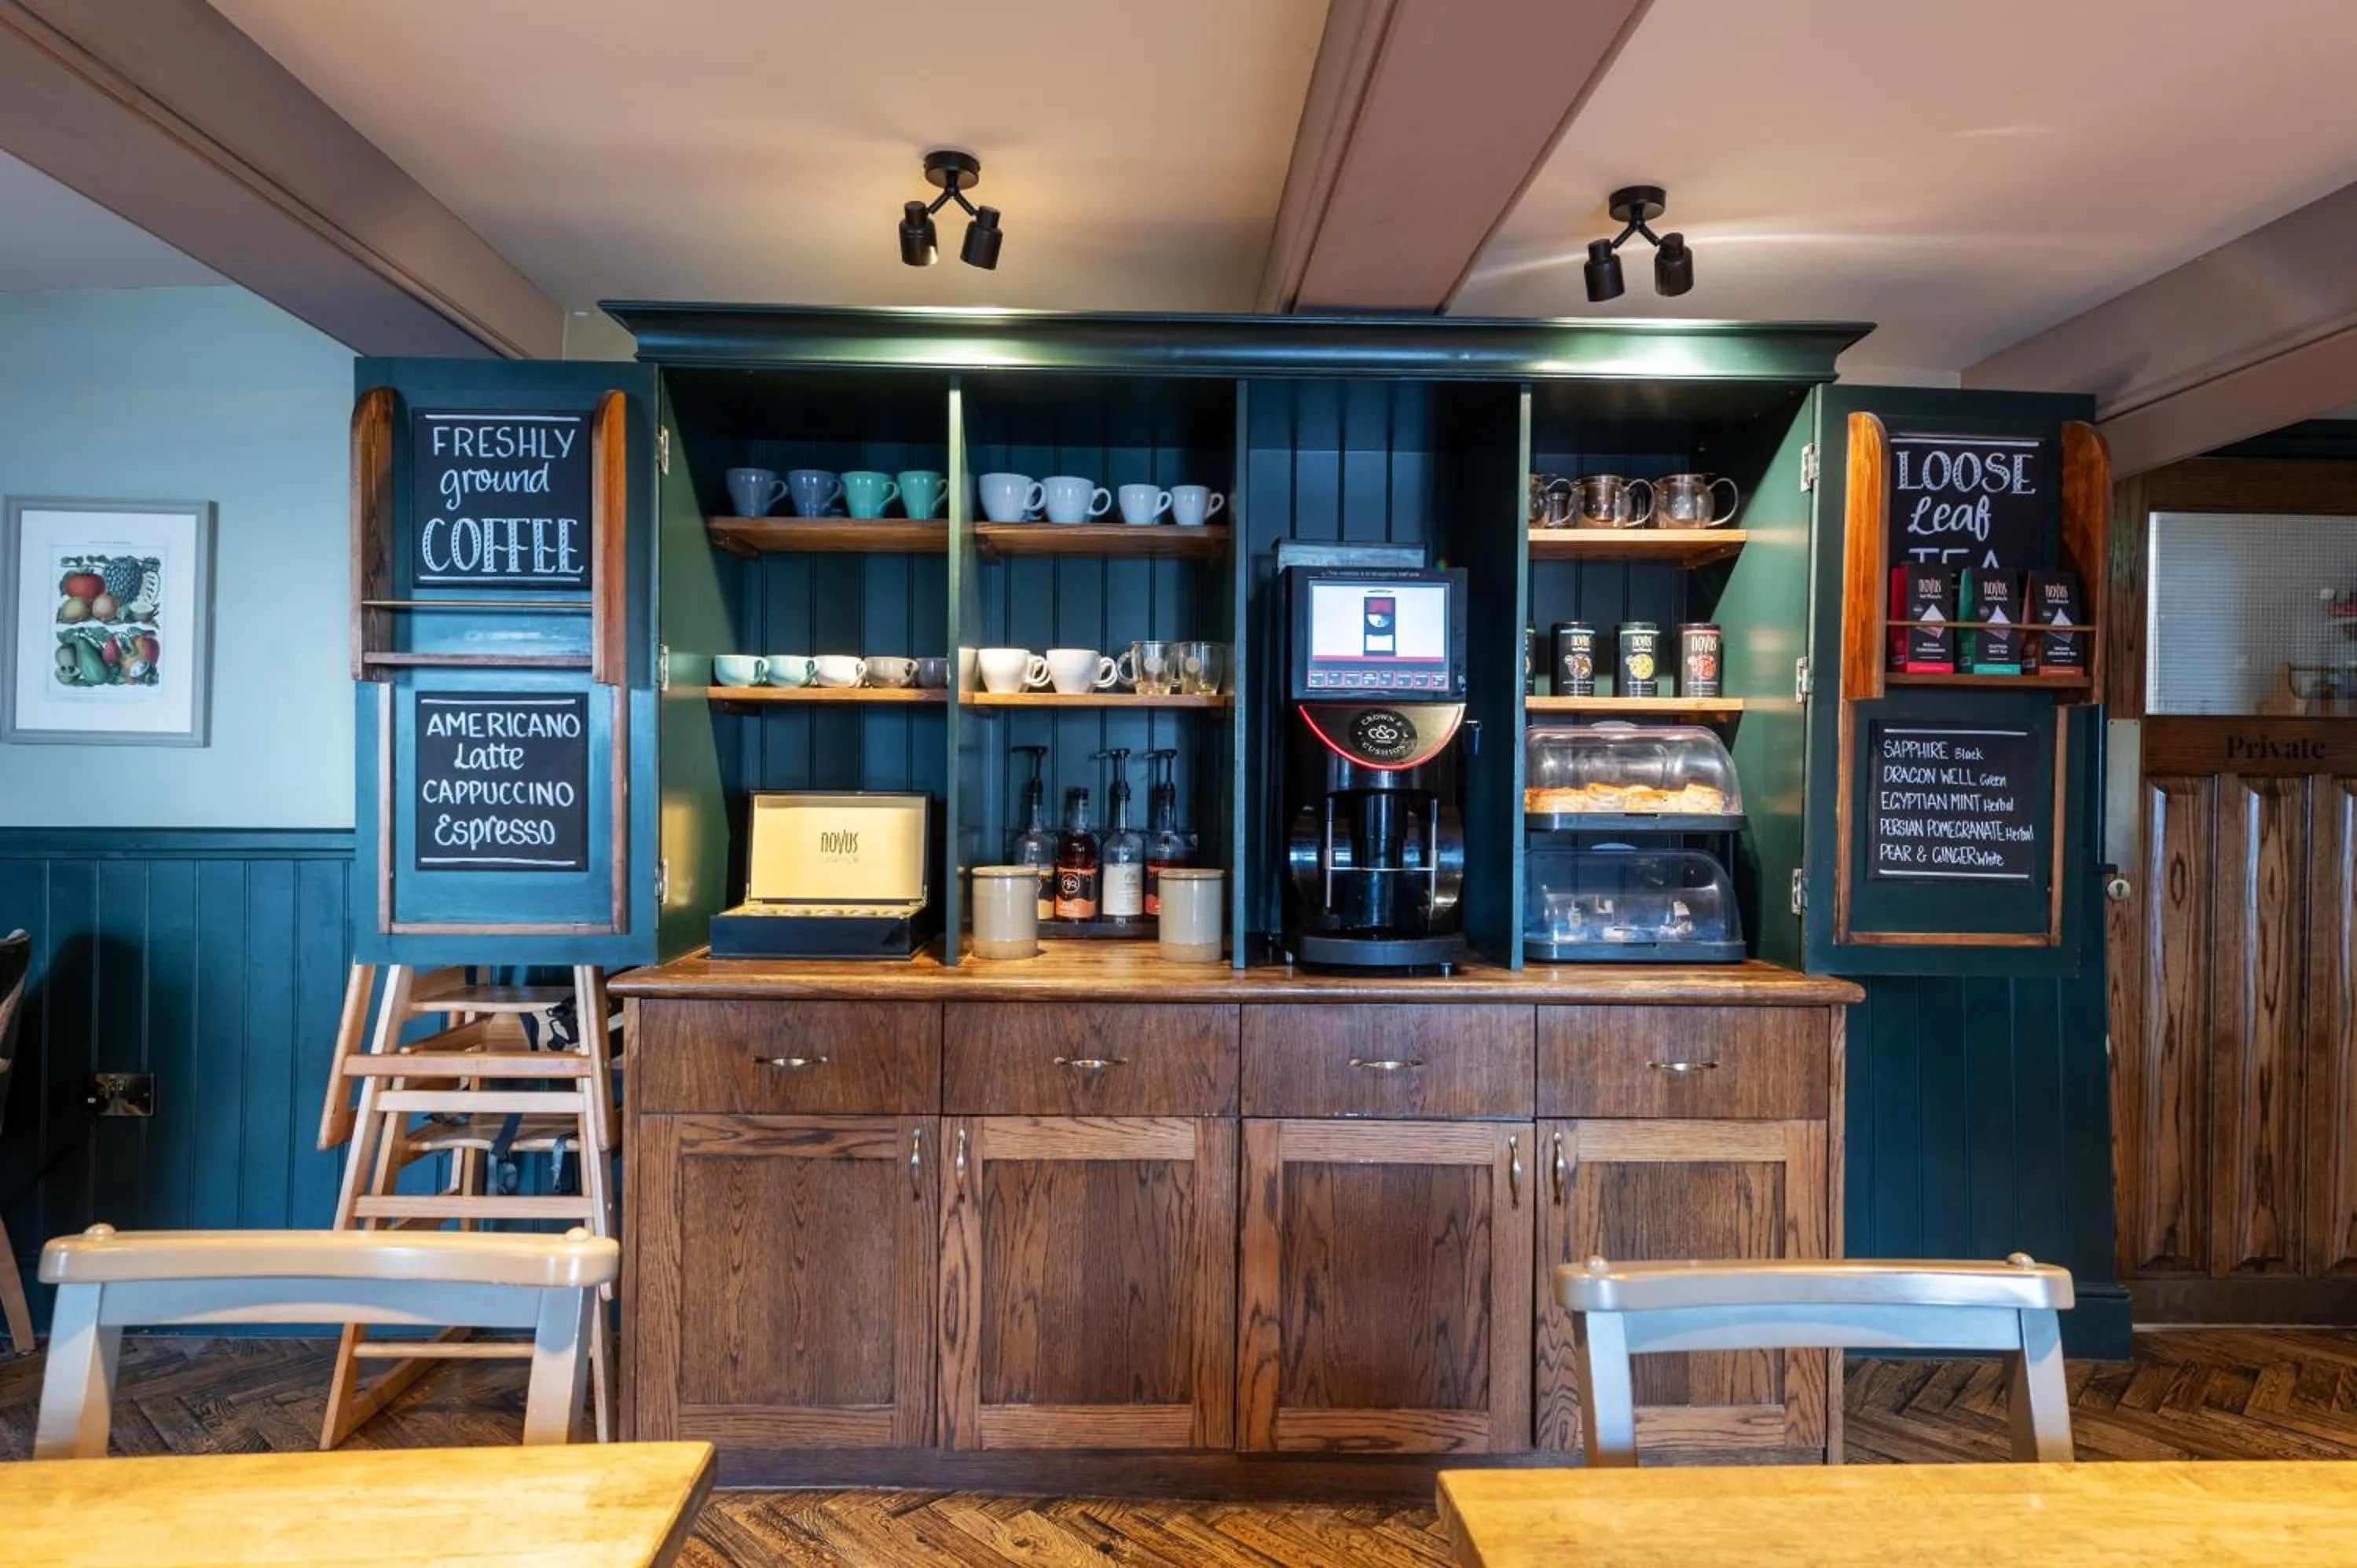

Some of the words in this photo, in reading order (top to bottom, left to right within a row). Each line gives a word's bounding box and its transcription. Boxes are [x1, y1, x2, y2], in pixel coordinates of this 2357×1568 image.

[432, 426, 576, 459] FRESHLY
[439, 462, 551, 511] ground
[1896, 451, 2036, 495] LOOSE
[1907, 495, 1992, 542] Leaf
[422, 518, 585, 573] COFFEE
[427, 712, 581, 738] AMERICANO
[453, 742, 525, 771] Latte
[1883, 739, 1949, 760] SAPPHIRE
[1955, 748, 1985, 760] Black
[2227, 734, 2326, 760] Private
[1883, 766, 1936, 784] DRAGON
[1940, 768, 1977, 786] WELL
[423, 779, 574, 807] CAPPUCCINO
[1881, 791, 1948, 811] EGYPTIAN
[1951, 793, 1981, 812] MINT
[1983, 797, 2014, 812] Herbal
[434, 814, 555, 850] Espresso
[820, 829, 859, 855] novus
[1879, 817, 1925, 837] PERSIAN
[1927, 819, 2005, 841] POMEGRANATE
[1879, 843, 1912, 862] PEAR
[1916, 844, 1926, 863] &
[1932, 846, 1977, 865] GINGER
